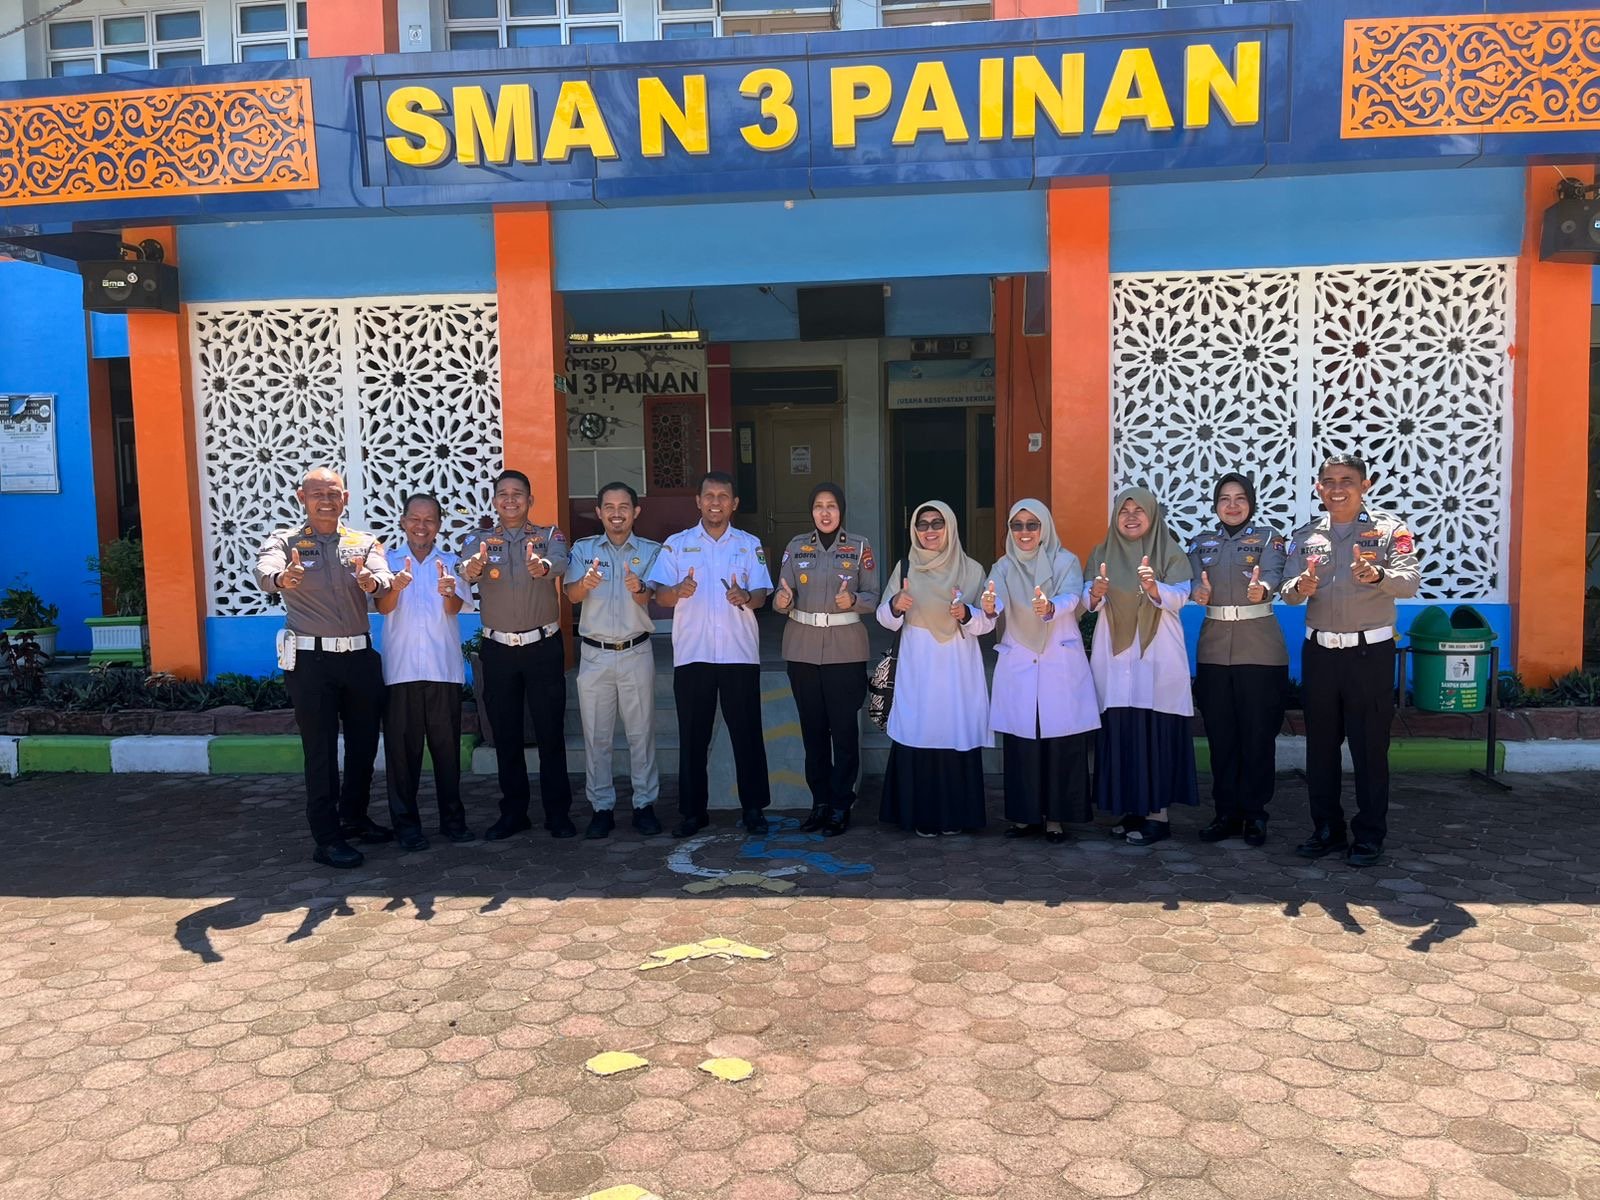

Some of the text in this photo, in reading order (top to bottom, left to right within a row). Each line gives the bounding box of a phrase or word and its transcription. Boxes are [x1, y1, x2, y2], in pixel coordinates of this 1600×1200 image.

[738, 67, 799, 153] 3
[829, 40, 1261, 148] PAINAN
[564, 354, 617, 372] (PTSP)
[583, 373, 597, 395] 3
[601, 371, 699, 394] PAINAN
[341, 547, 367, 555] POLRI
